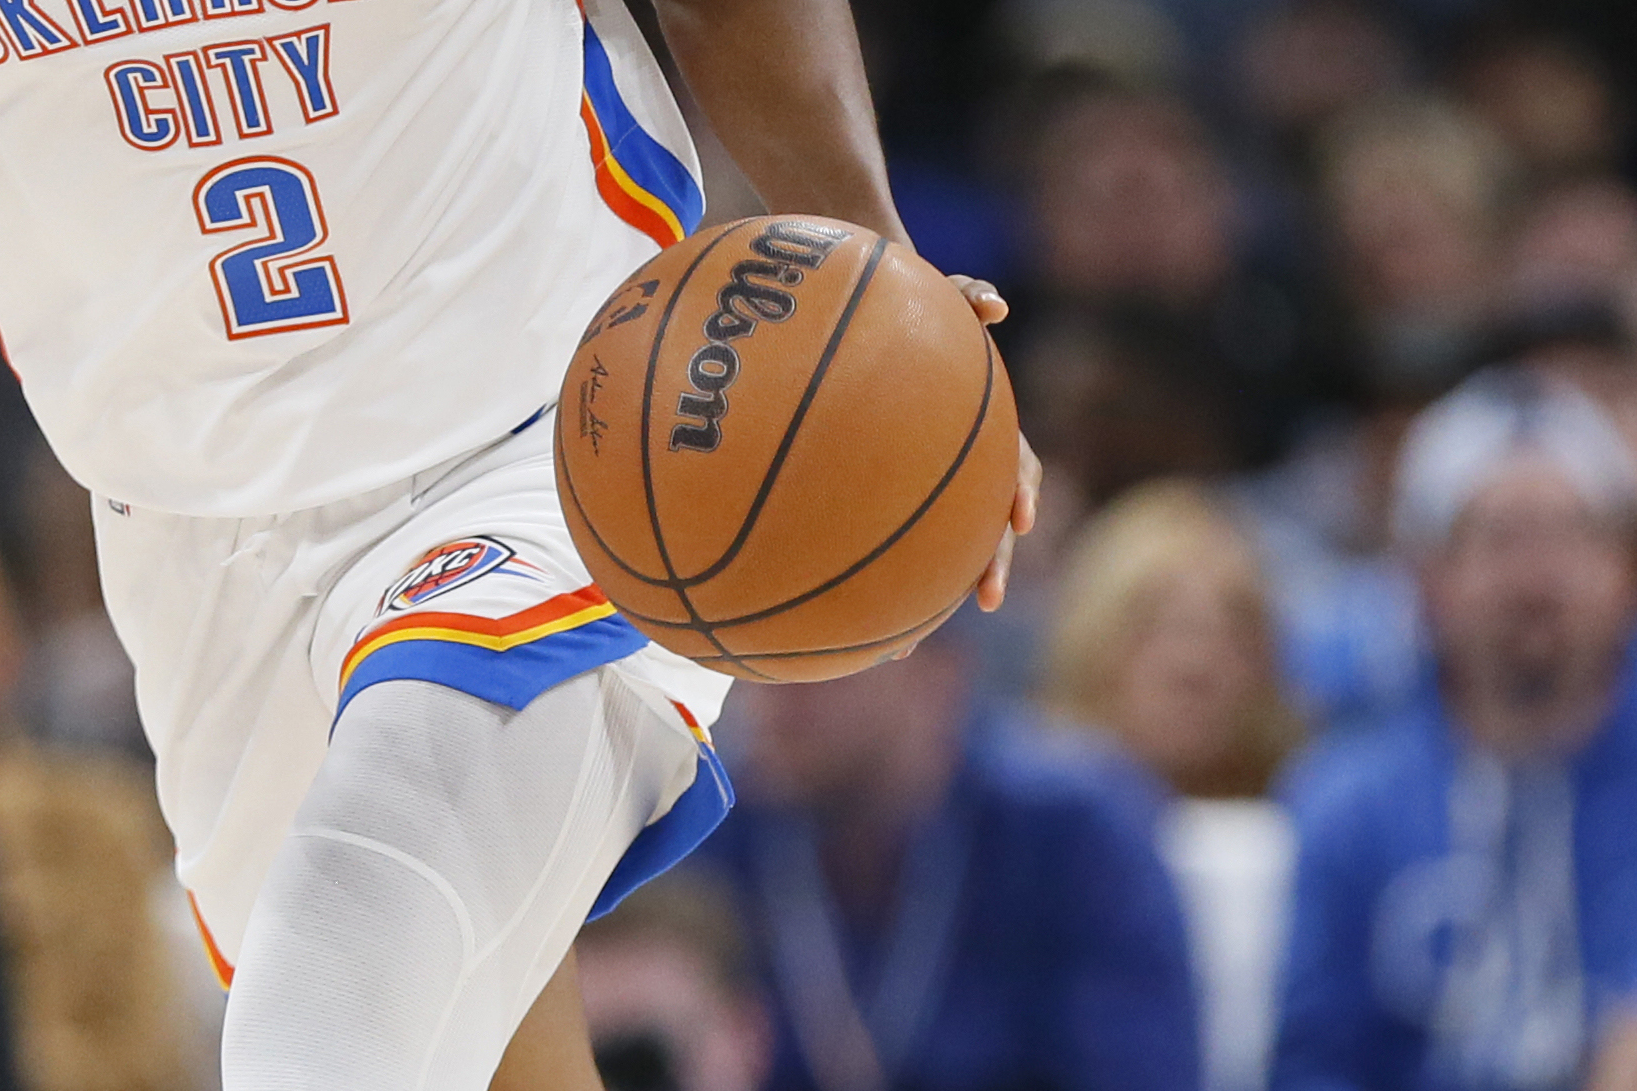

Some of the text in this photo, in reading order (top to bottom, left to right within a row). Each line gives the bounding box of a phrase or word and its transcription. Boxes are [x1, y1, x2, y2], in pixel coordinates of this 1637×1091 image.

[104, 24, 339, 151] CITY
[193, 156, 349, 340] 2
[667, 220, 855, 452] Wilson
